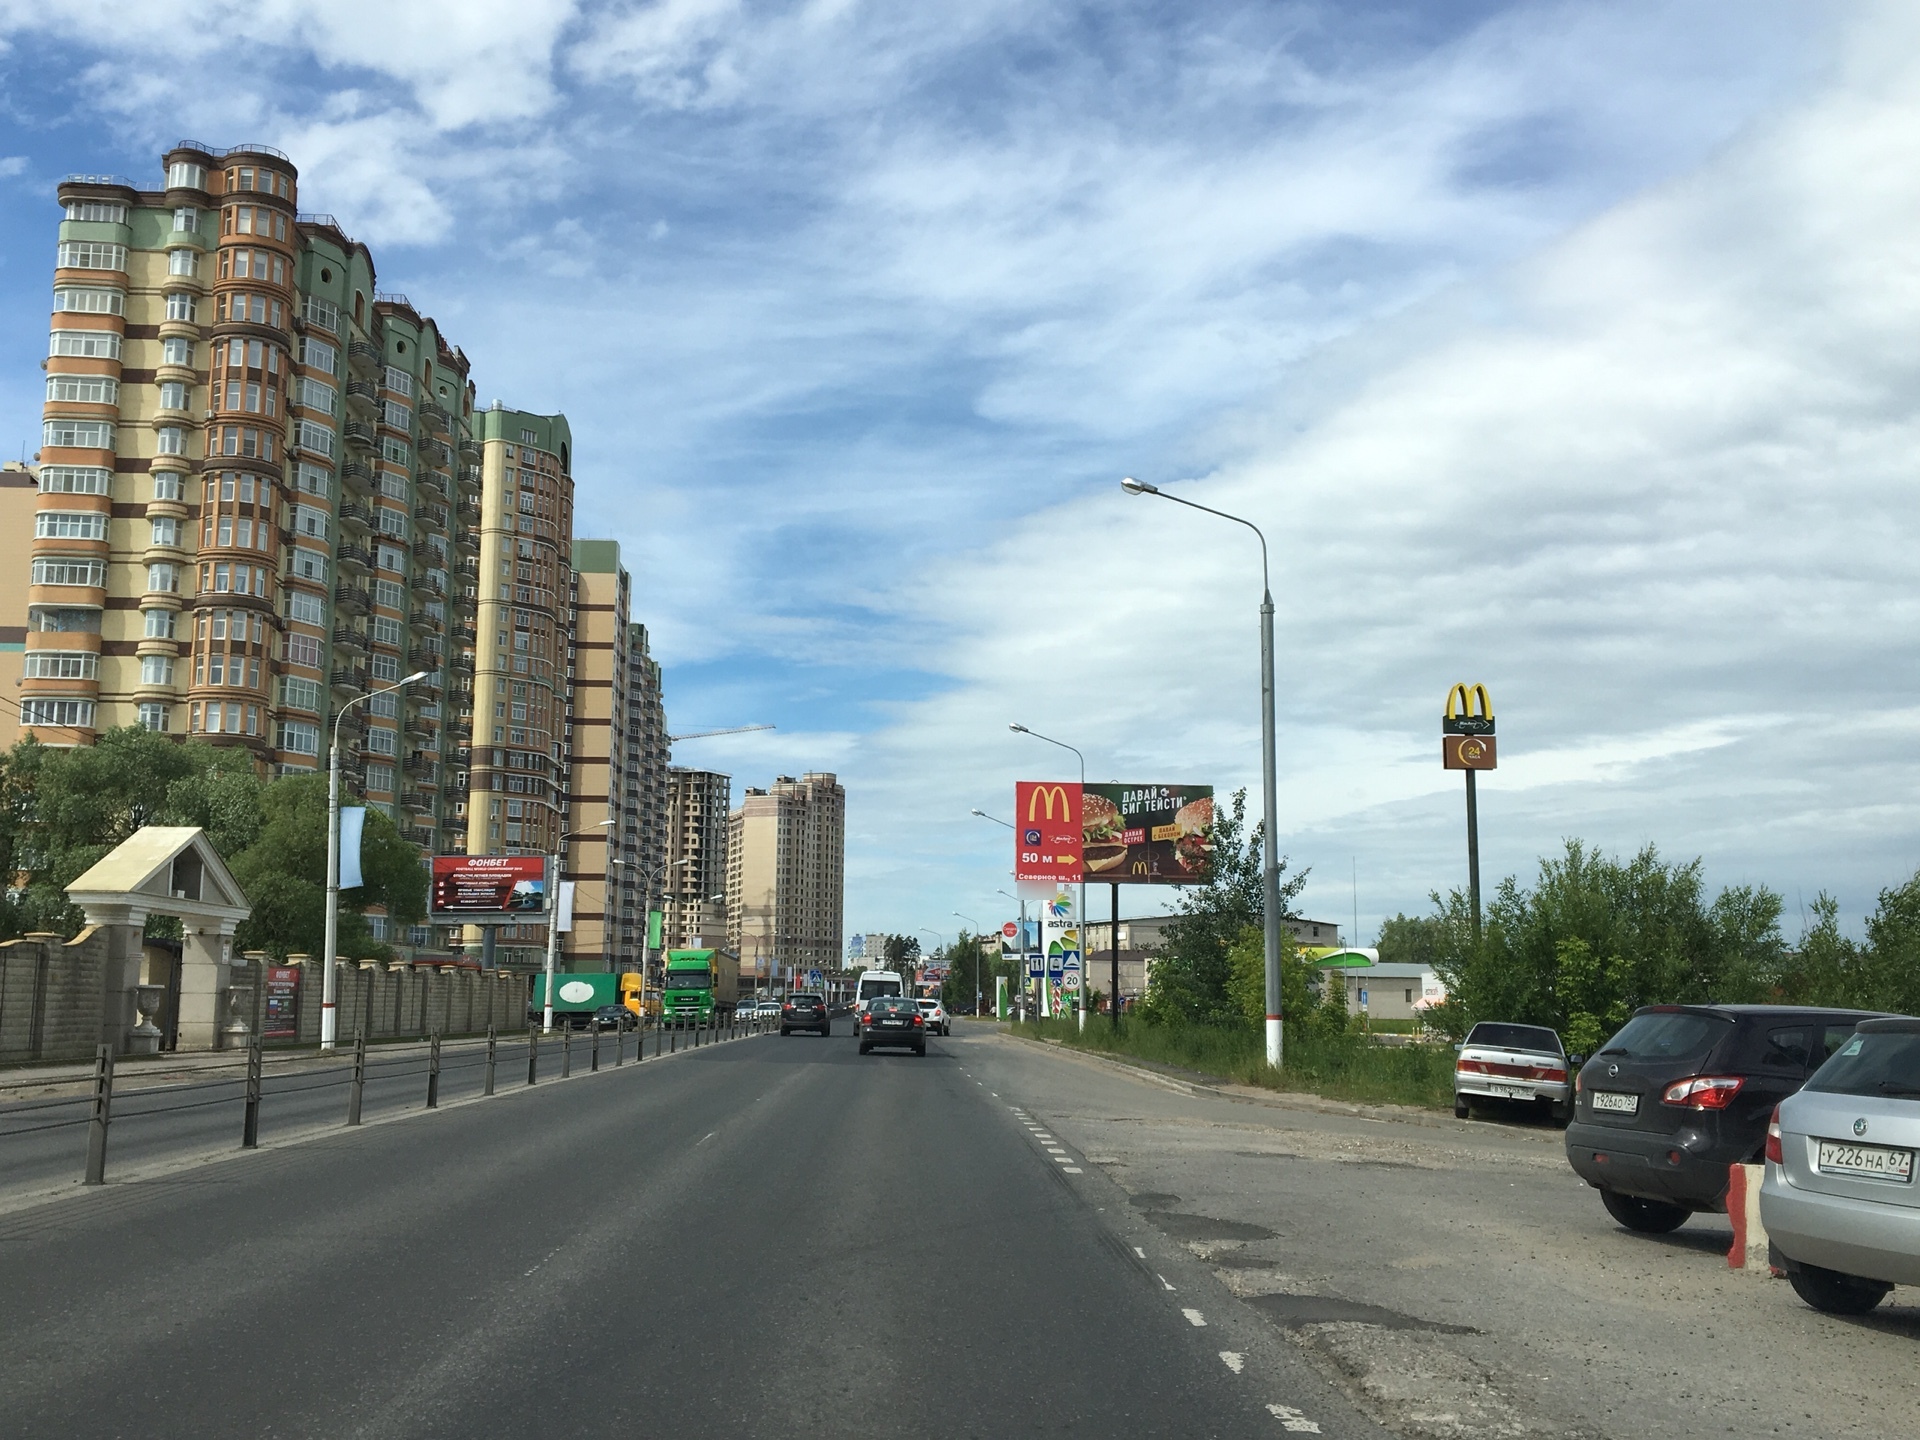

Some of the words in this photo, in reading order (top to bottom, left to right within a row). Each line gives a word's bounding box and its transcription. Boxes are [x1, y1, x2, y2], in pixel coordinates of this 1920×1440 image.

[1468, 746, 1480, 755] 24
[1122, 786, 1157, 803] ДАВАЙ
[1122, 802, 1141, 815] БИГ
[1145, 797, 1183, 812] ТЕЙСТИ
[1022, 852, 1038, 863] 50
[468, 859, 509, 867] ФОНБЕТ
[1018, 873, 1057, 881] Северное
[1047, 920, 1073, 928] astra
[1066, 977, 1078, 985] 20
[1889, 1152, 1906, 1167] 67
